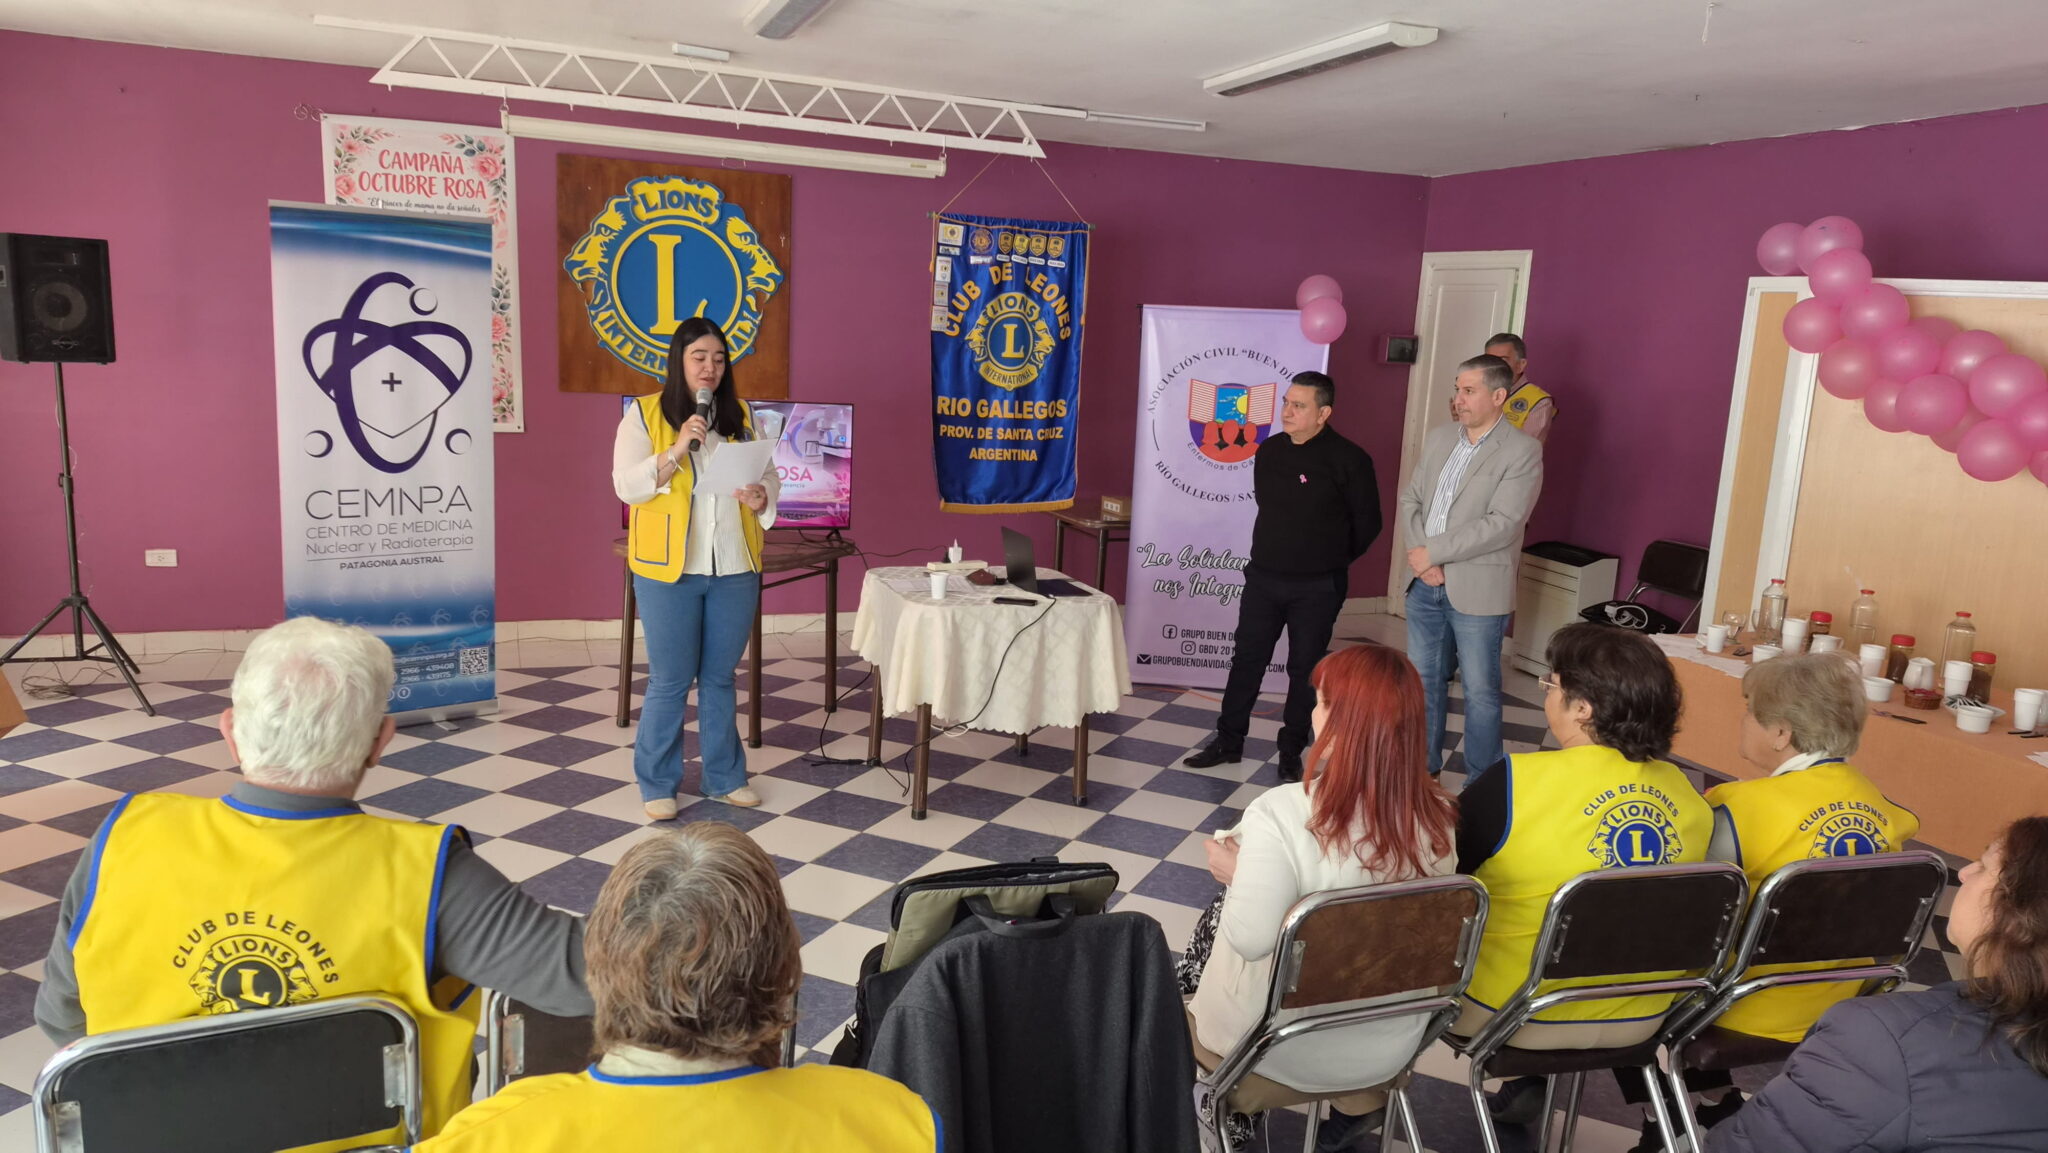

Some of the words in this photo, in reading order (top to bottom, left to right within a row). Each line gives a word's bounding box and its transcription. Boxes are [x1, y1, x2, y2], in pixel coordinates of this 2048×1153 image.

[378, 149, 465, 175] CAMPAÑA
[358, 170, 438, 198] OCTUBRE
[443, 177, 487, 200] ROSA
[639, 190, 713, 217] LIONS
[648, 234, 708, 335] L
[944, 280, 981, 337] CLUB
[989, 262, 1013, 285] DE
[1025, 266, 1071, 340] LEONES
[990, 295, 1038, 320] LIONS
[599, 316, 757, 372] INTERNAL
[1001, 324, 1024, 358] L
[984, 364, 1034, 385] INTERNATIONAL
[1148, 353, 1201, 412] ASOCIACIÓN
[1204, 346, 1239, 359] CIVIL
[1279, 366, 1294, 381] DÍ
[936, 395, 972, 418] RIO
[976, 399, 1067, 420] GALLEGOS
[939, 424, 974, 439] PROV.
[977, 427, 993, 440] DE
[996, 428, 1034, 441] SANTA
[1037, 427, 1064, 440] CRUZ
[969, 447, 1038, 461] ARGENTINA
[1187, 441, 1224, 471] Enfermos
[775, 466, 813, 481] OSA
[1155, 460, 1173, 480] RÍO
[1171, 476, 1231, 503] GALLEGOS
[1238, 490, 1255, 502] SA
[306, 524, 373, 540] CENTRO
[377, 522, 398, 535] DE
[402, 519, 473, 534] MEDICINA
[306, 542, 363, 555] Nuclear
[369, 543, 376, 553] y
[381, 535, 473, 551] Radioterapia
[1177, 545, 1251, 571] Solidar
[339, 559, 398, 570] PATAGONIA
[400, 556, 444, 567] AUSTRAL
[1154, 578, 1184, 599] nos
[1189, 572, 1244, 606] Integr
[1181, 629, 1206, 640] GRUPO
[1206, 629, 1226, 641] BUEN
[1583, 790, 1616, 817] CLUB
[1618, 783, 1637, 795] DE
[1641, 783, 1679, 818] LEONES
[1610, 804, 1663, 824] LIONS
[1798, 807, 1827, 832] CLUB
[1829, 801, 1846, 812] DE
[1848, 801, 1889, 826] LEONES
[1826, 816, 1873, 834] LIONS
[1629, 830, 1655, 862] L
[172, 919, 217, 969] CLUB
[225, 911, 256, 926] DE
[266, 914, 339, 984] LEONES
[218, 938, 292, 964] LIONS
[237, 968, 270, 1006] L
